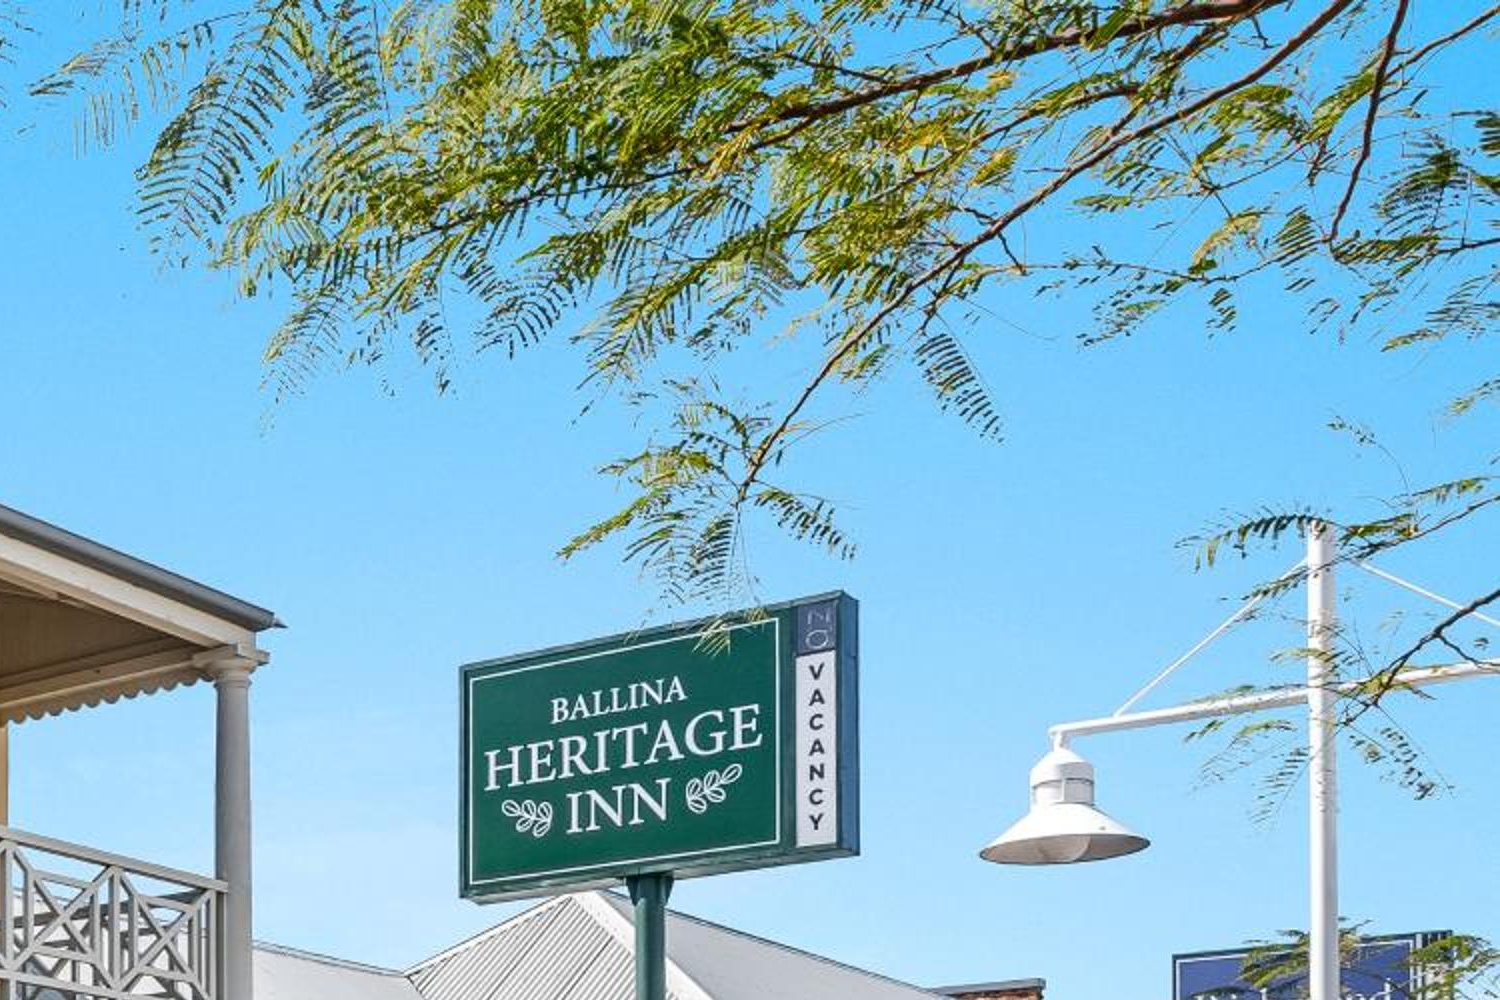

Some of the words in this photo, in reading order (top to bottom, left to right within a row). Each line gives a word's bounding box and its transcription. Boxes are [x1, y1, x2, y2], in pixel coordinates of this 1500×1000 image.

[550, 676, 688, 725] BALLINA
[484, 703, 764, 792] HERITAGE
[809, 662, 825, 831] VACANCY
[566, 778, 671, 834] INN
